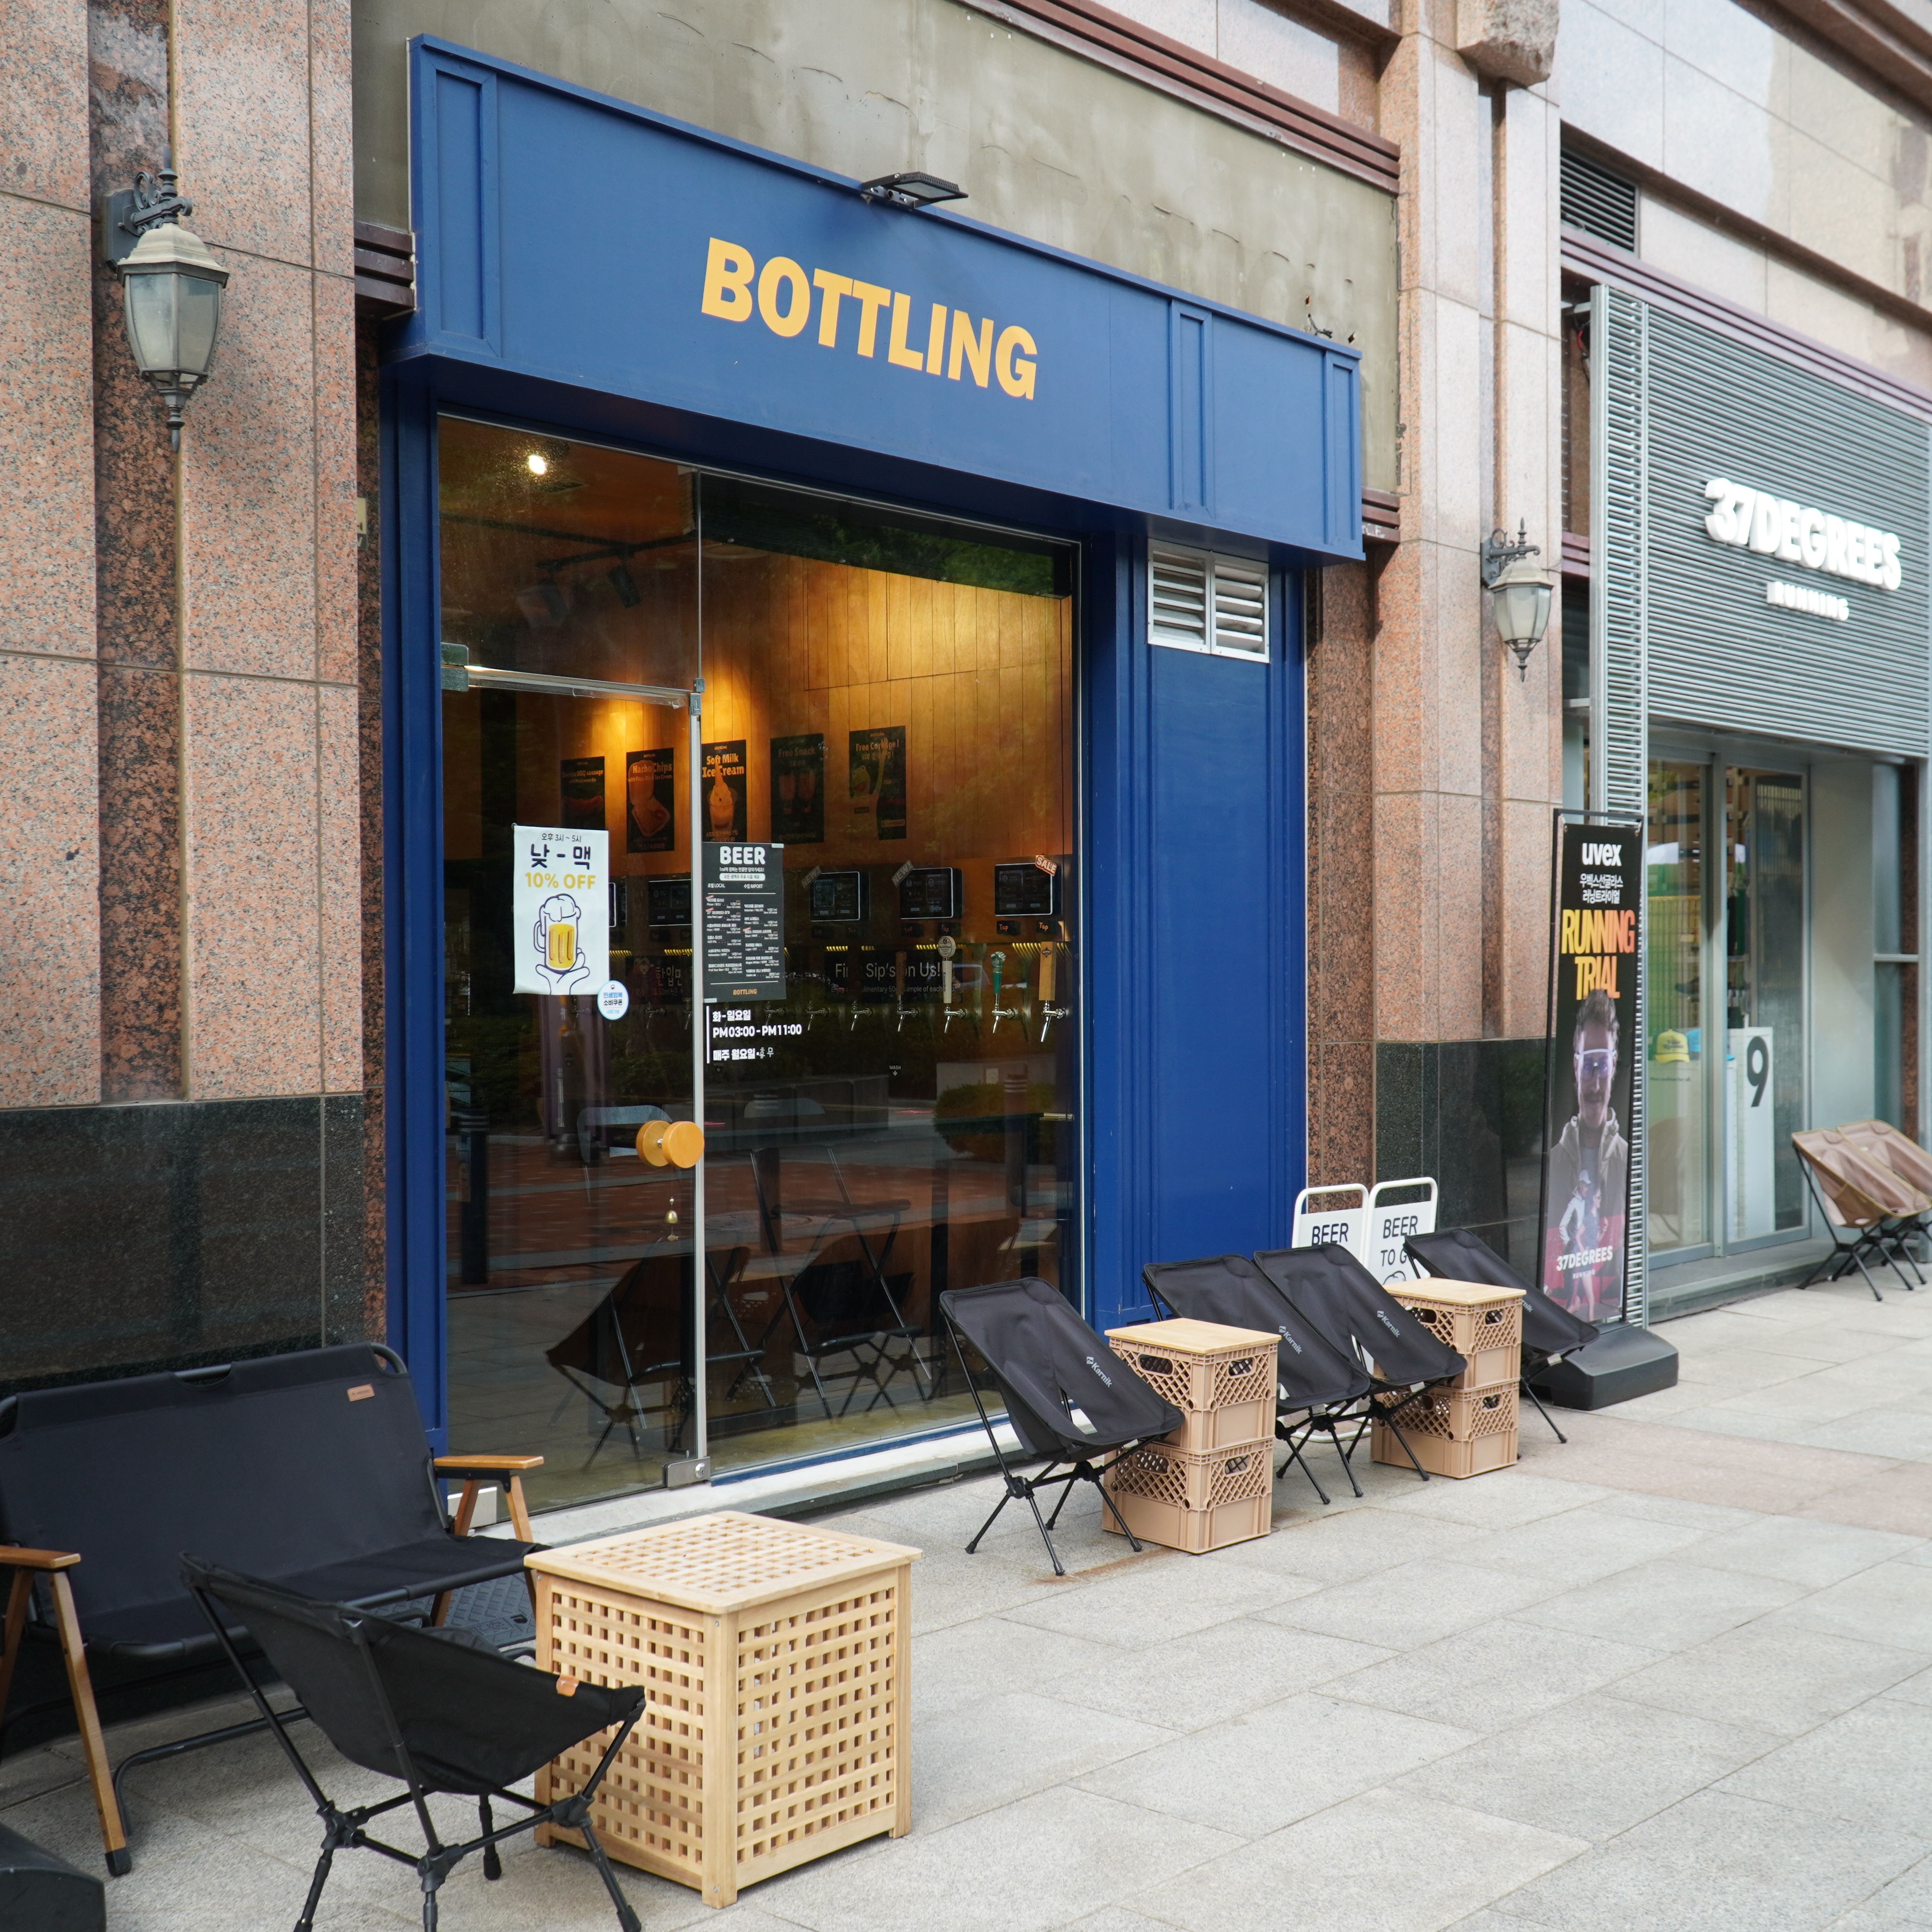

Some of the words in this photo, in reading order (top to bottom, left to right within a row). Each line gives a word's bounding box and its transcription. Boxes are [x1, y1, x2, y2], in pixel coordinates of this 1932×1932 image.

[701, 237, 1037, 401] BOTTLING
[1705, 477, 1902, 591] 37DEGREES
[1766, 581, 1849, 621] RUNNING
[795, 746, 815, 757] Snack
[855, 743, 869, 752] Free
[632, 764, 652, 774] Nacho
[653, 762, 672, 774] Chips
[706, 754, 721, 765] Soft
[722, 753, 739, 764] Milk
[702, 766, 716, 778] Ice
[541, 833, 553, 841] 오후
[571, 835, 582, 843] 5시
[530, 843, 550, 868] 낮
[573, 846, 591, 870] 맥
[720, 846, 766, 865] BEER
[1582, 842, 1622, 867] uvex
[892, 860, 913, 884] NEW!
[1036, 856, 1057, 875] SALE
[525, 872, 559, 888] 10%
[563, 873, 596, 889] OFF
[940, 924, 950, 934] Tap
[999, 923, 1009, 932] Tap
[1038, 922, 1049, 932] Tap
[1561, 909, 1635, 954] RUNNING
[905, 966, 916, 978] n
[920, 962, 941, 978] Us!
[1574, 955, 1620, 1001] TRIAL
[713, 1049, 730, 1061] 매주
[1747, 1036, 1769, 1108] 9
[1311, 1222, 1349, 1246] BEER
[1383, 1215, 1418, 1239] BEER
[1380, 1249, 1396, 1267] TO
[1400, 1248, 1408, 1264] G
[1556, 1245, 1613, 1272] 37DEGREES
[1521, 1299, 1534, 1313] rnik
[1381, 1315, 1401, 1338] Karnik
[1283, 1331, 1303, 1354] Karnik
[1091, 1362, 1113, 1388] Karnik
